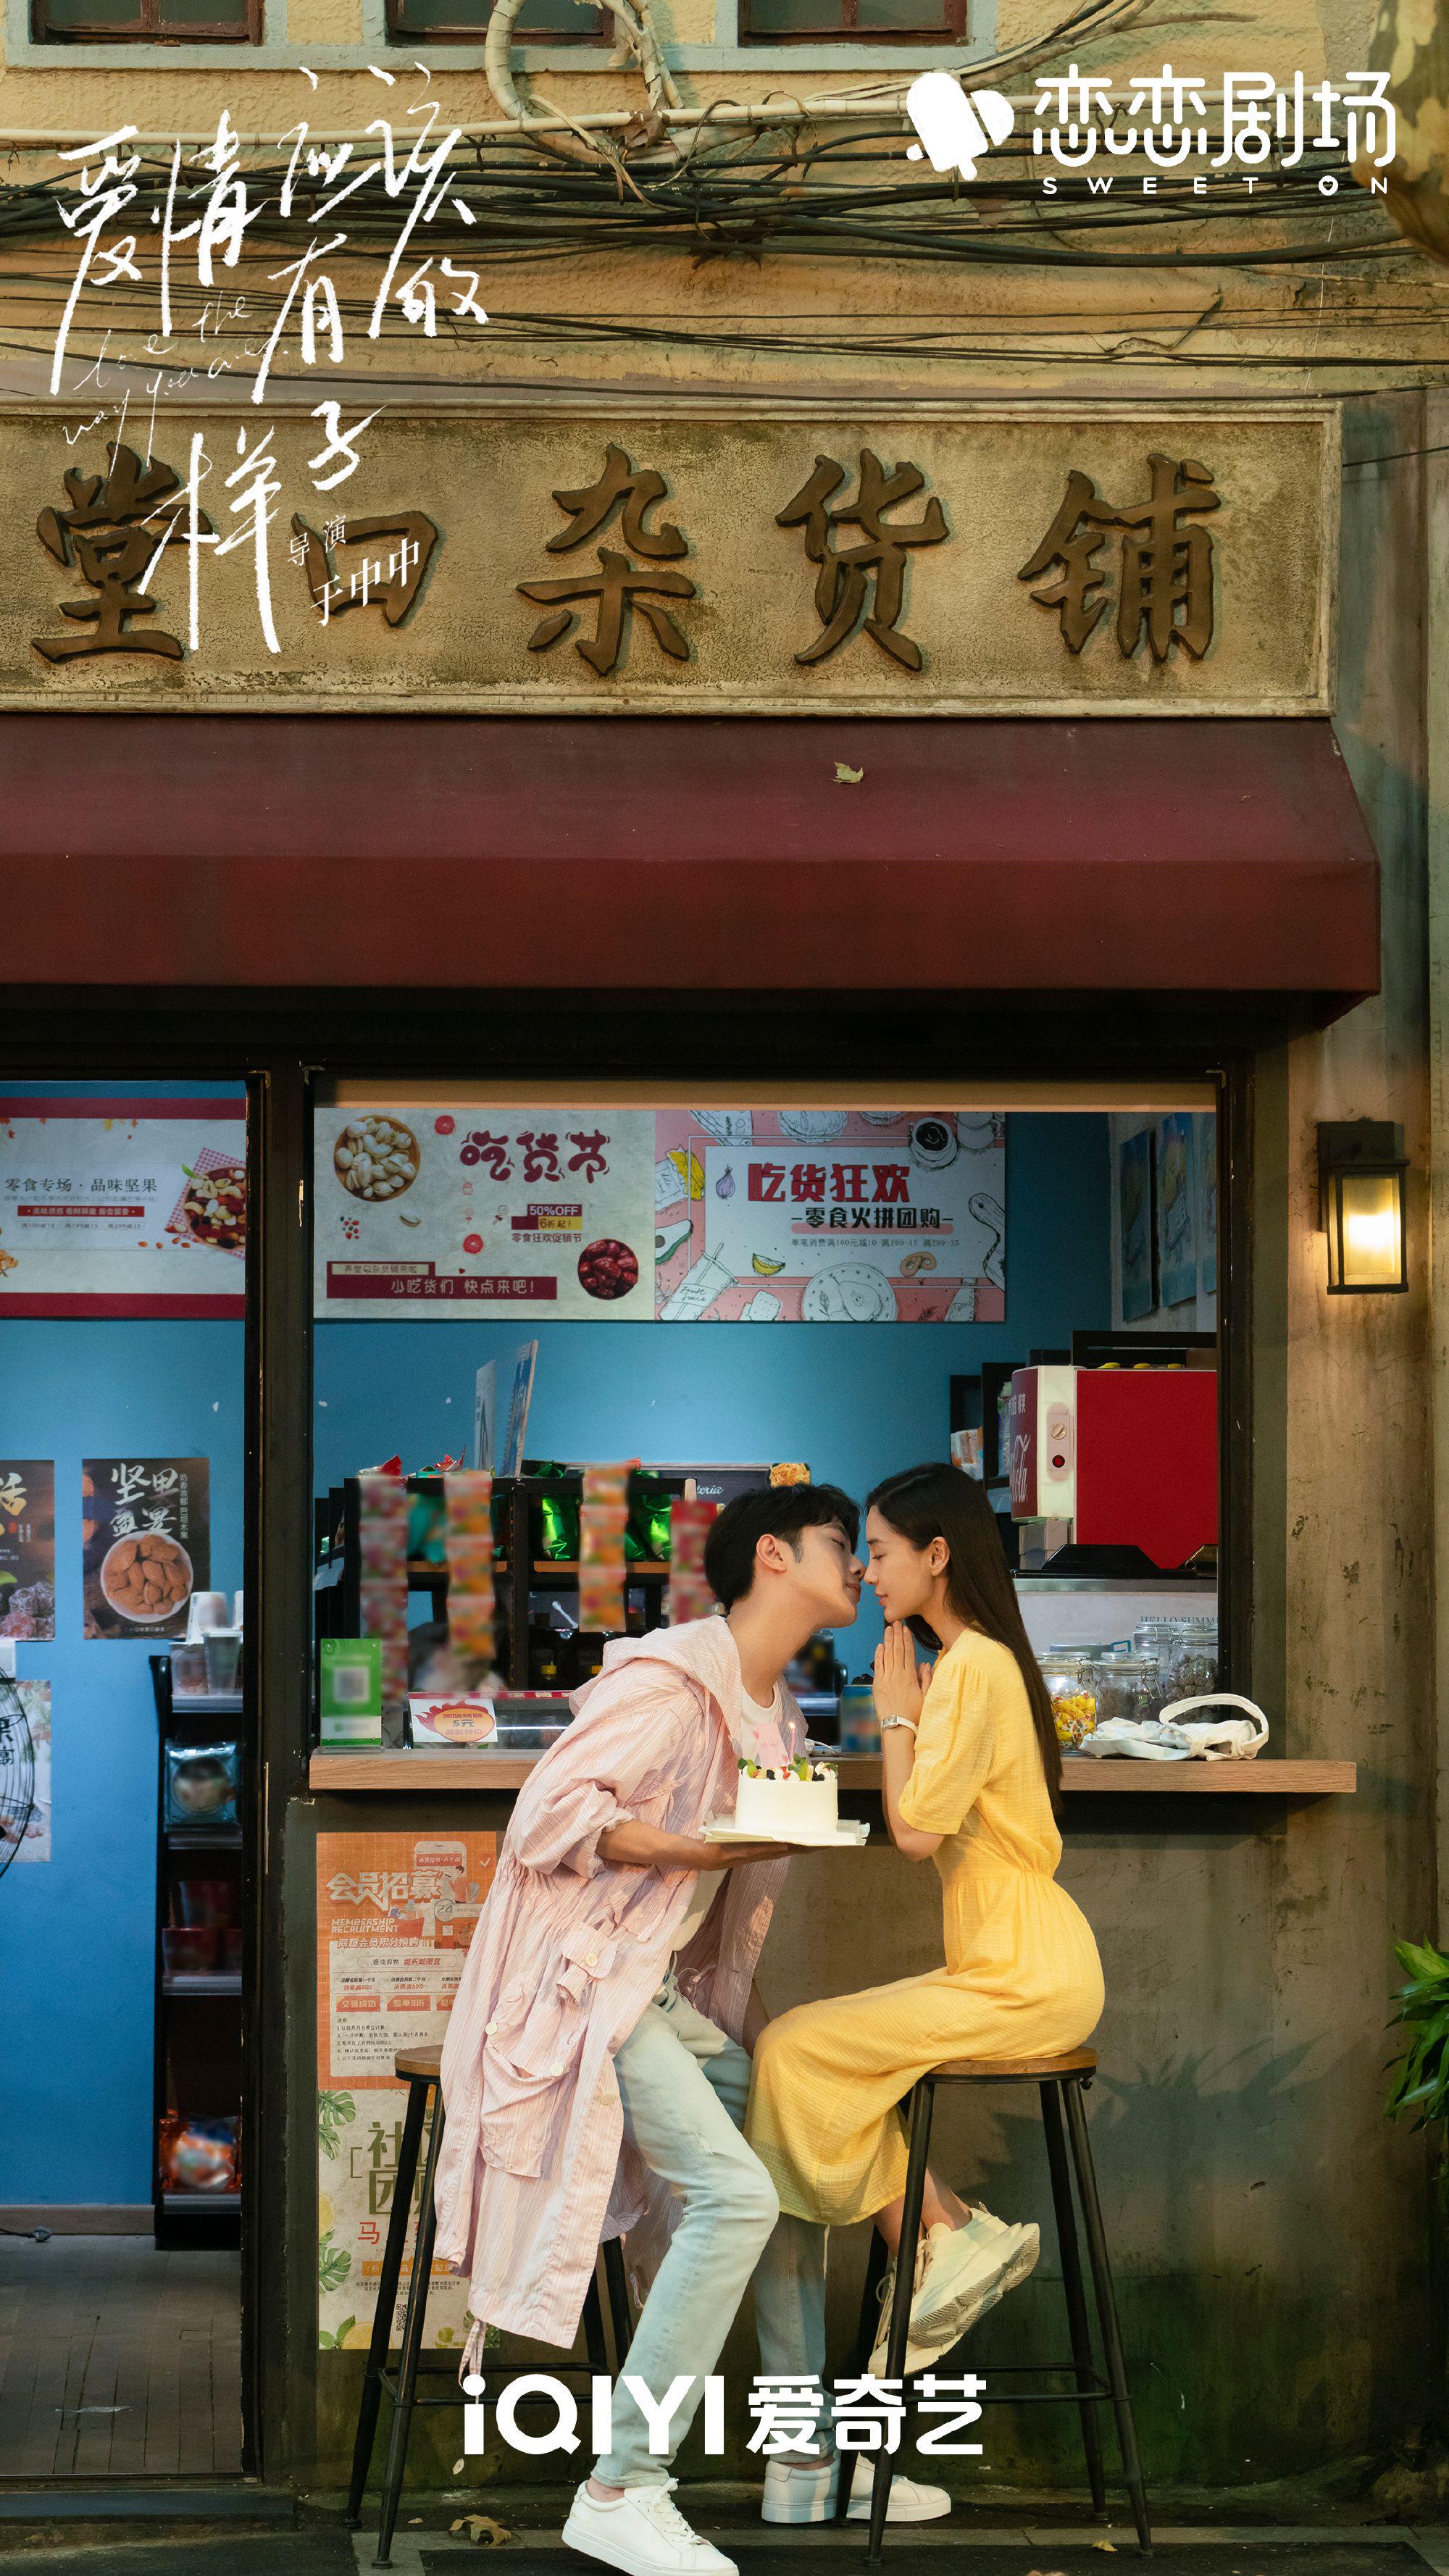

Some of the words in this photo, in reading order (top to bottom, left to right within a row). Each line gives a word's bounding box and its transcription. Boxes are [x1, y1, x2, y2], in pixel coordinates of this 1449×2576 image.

[459, 1129, 611, 1184] 吃货节
[747, 1163, 911, 1203] 吃货狂欢
[530, 1205, 579, 1216] 50%OFF
[391, 1279, 454, 1295] 小吃货们
[326, 1870, 441, 1911] 会员招募
